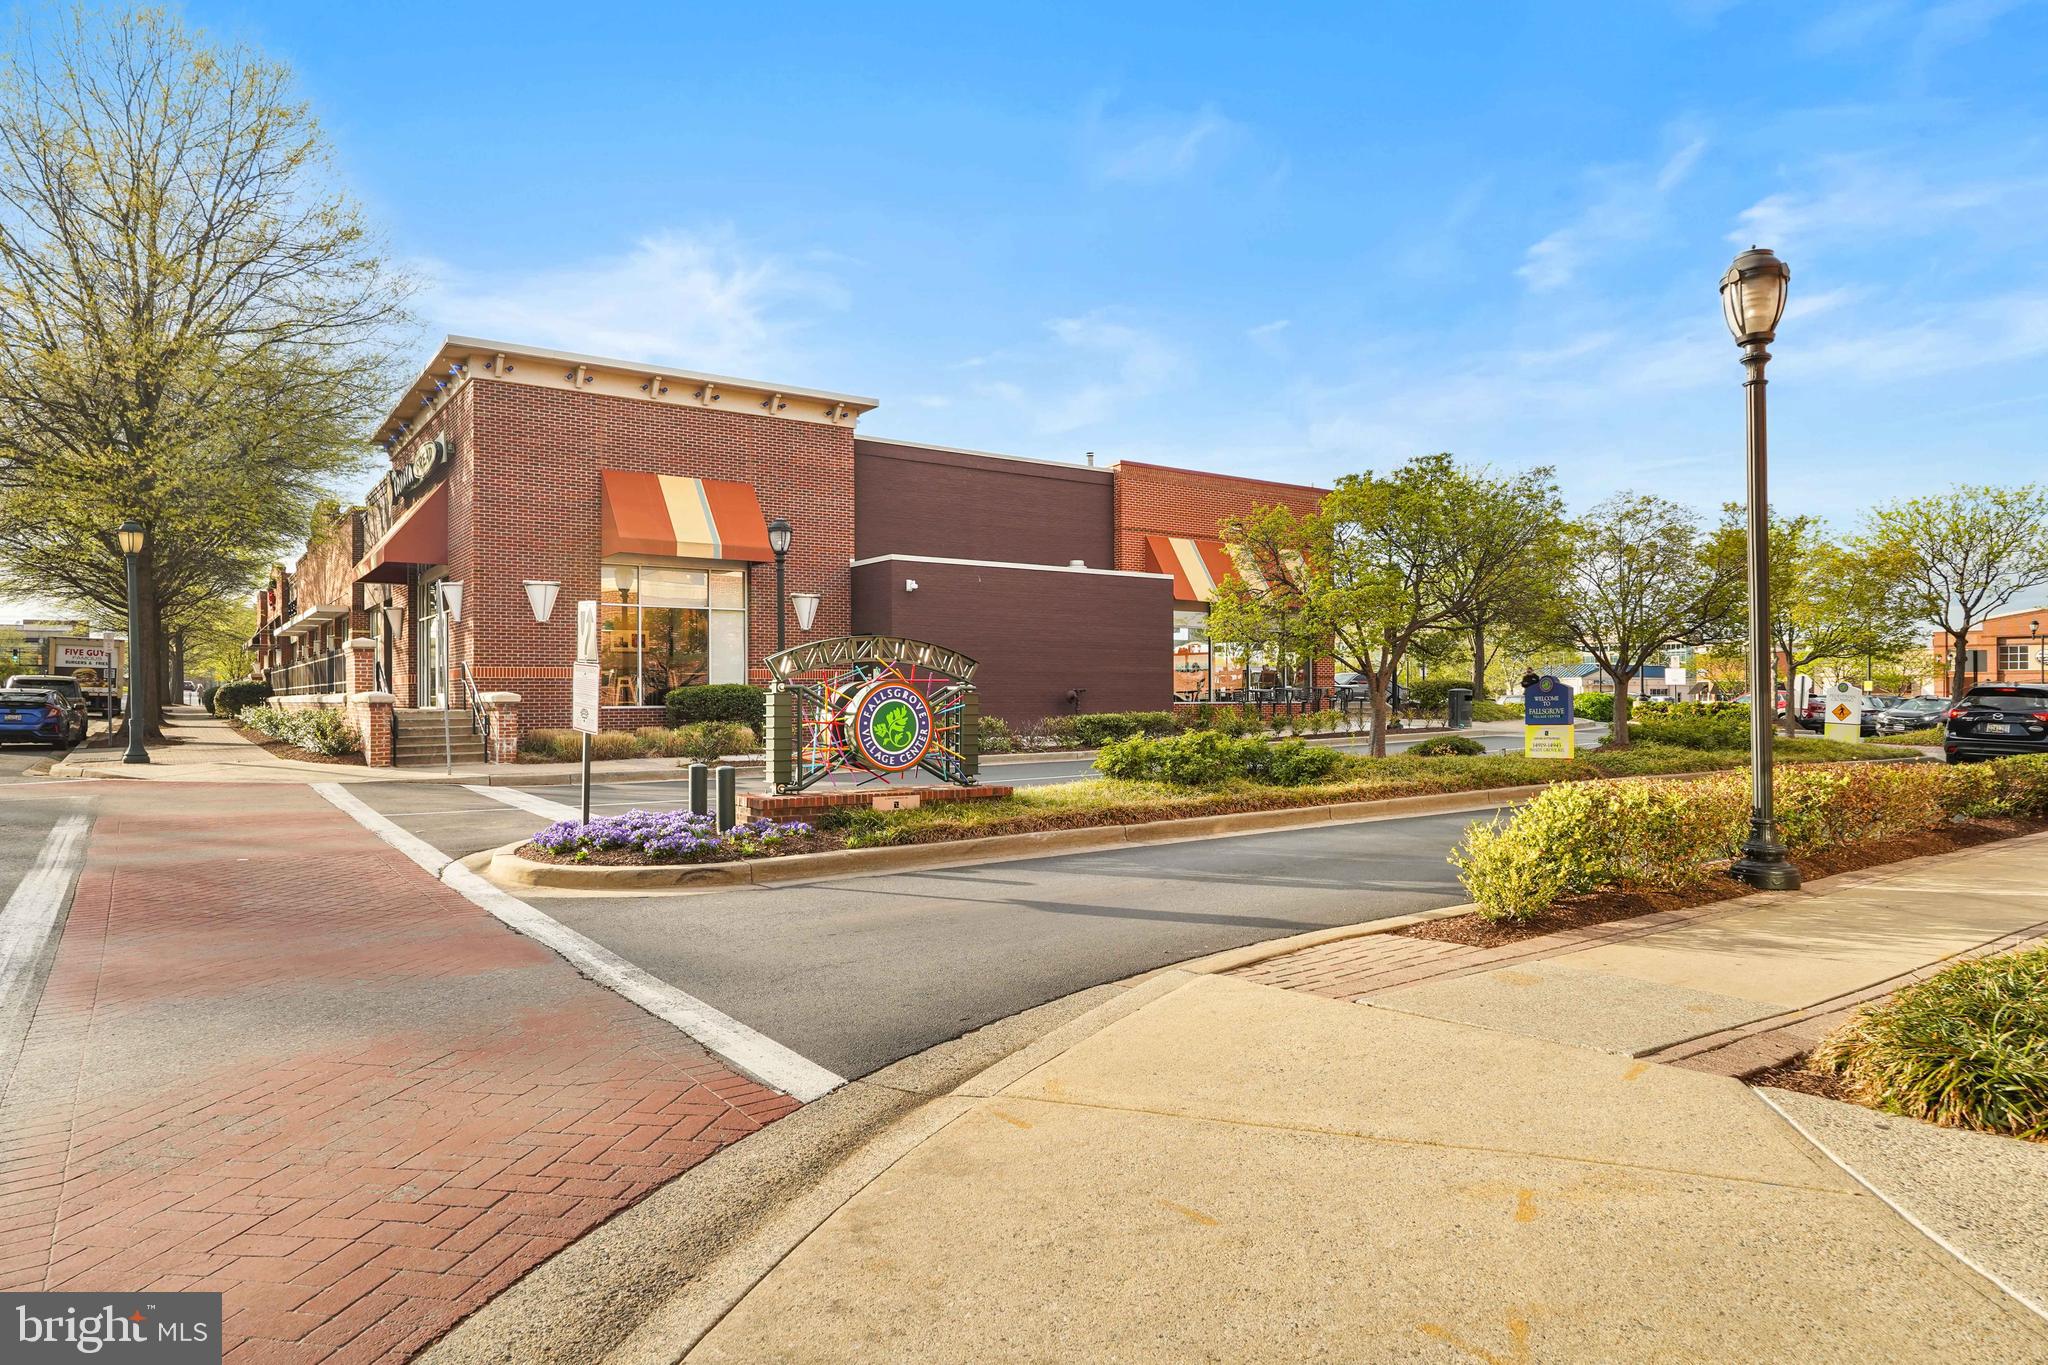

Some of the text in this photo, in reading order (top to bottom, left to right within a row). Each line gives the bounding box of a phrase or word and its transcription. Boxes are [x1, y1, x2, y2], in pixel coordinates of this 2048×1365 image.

[863, 688, 927, 719] FALLSGROVE
[862, 728, 928, 765] VILLAGE CENTER
